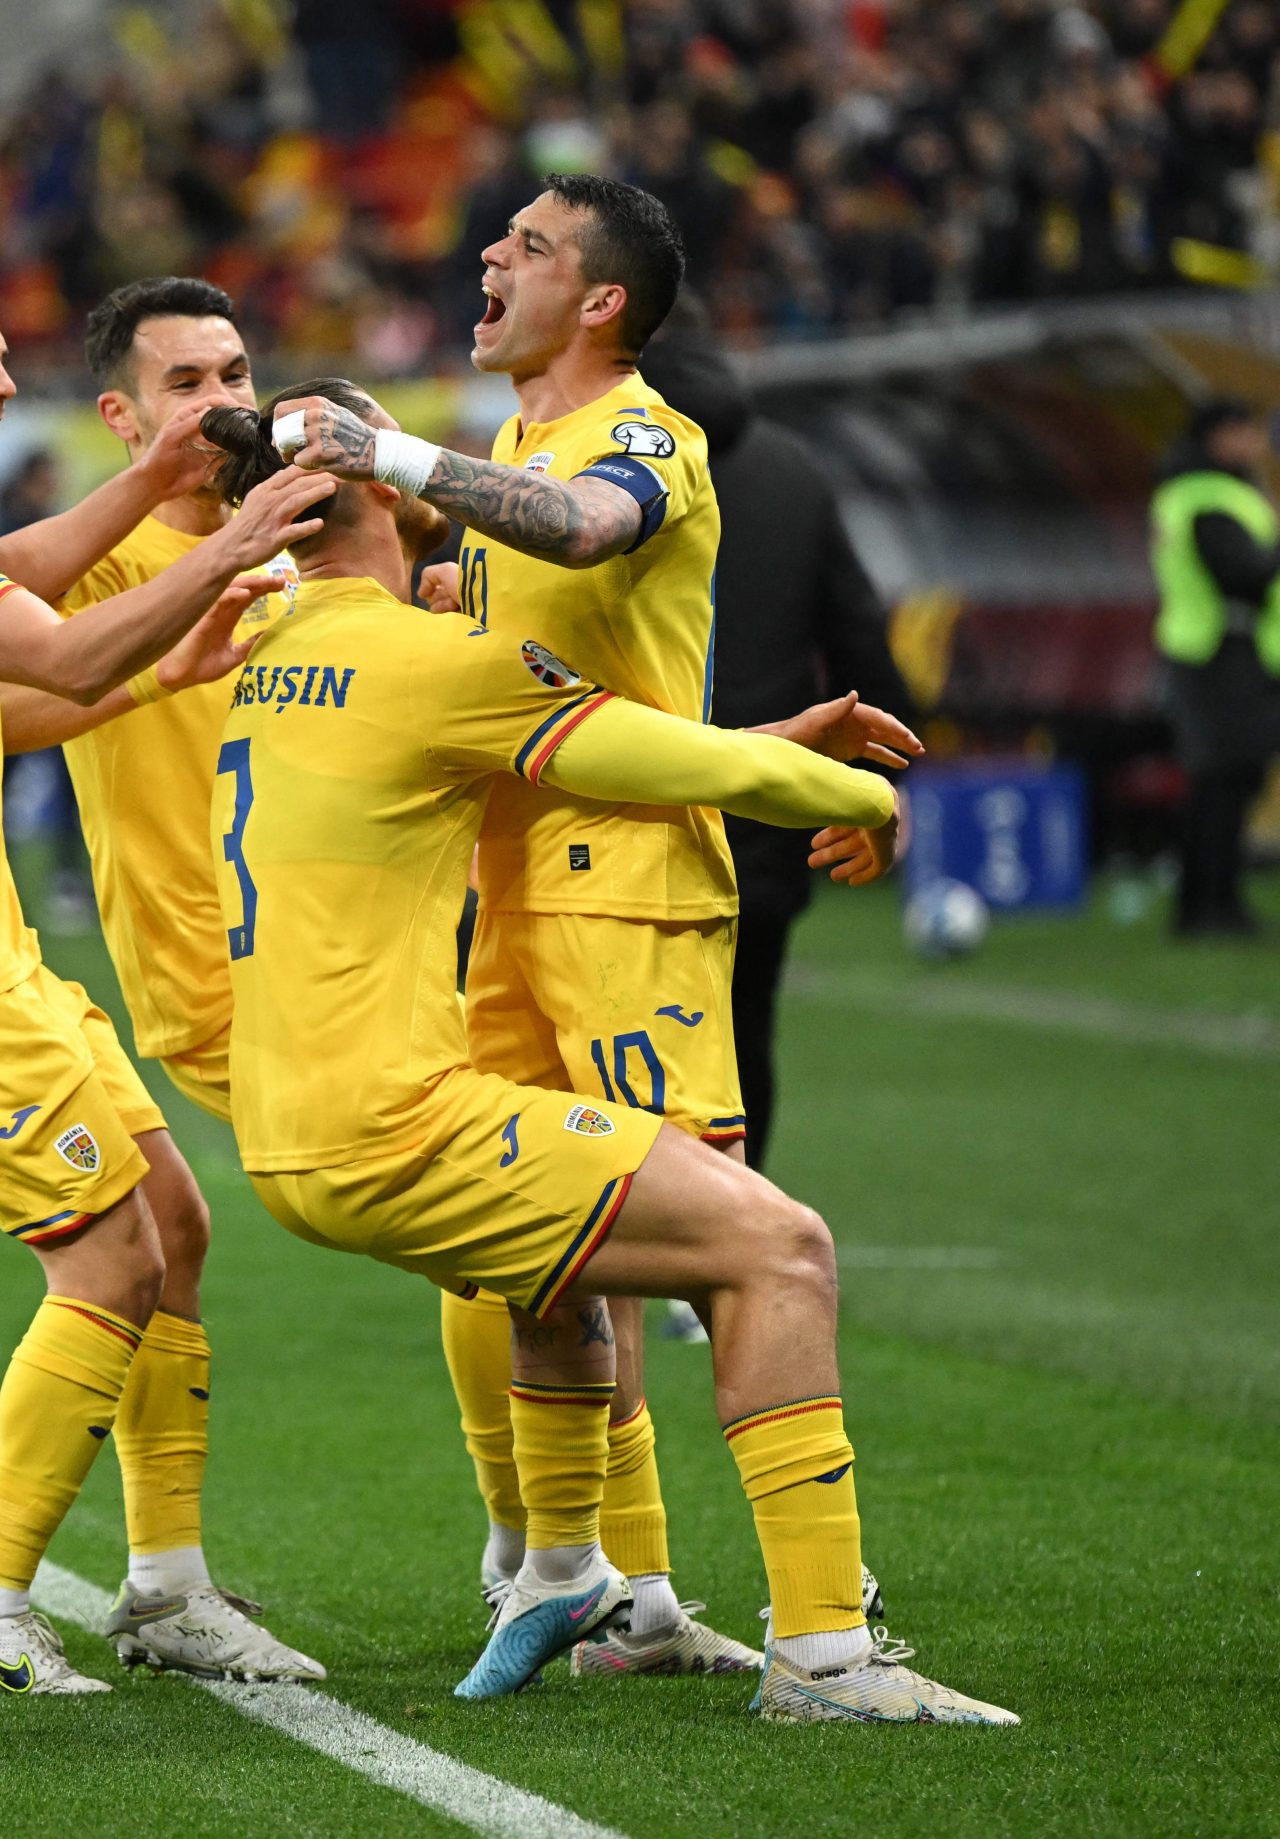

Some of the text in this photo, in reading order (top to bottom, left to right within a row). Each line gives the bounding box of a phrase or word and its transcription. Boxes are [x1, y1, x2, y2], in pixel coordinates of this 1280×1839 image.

[461, 547, 488, 627] 10
[216, 737, 258, 961] 3
[591, 1030, 666, 1114] 10
[811, 1667, 847, 1681] Drago
